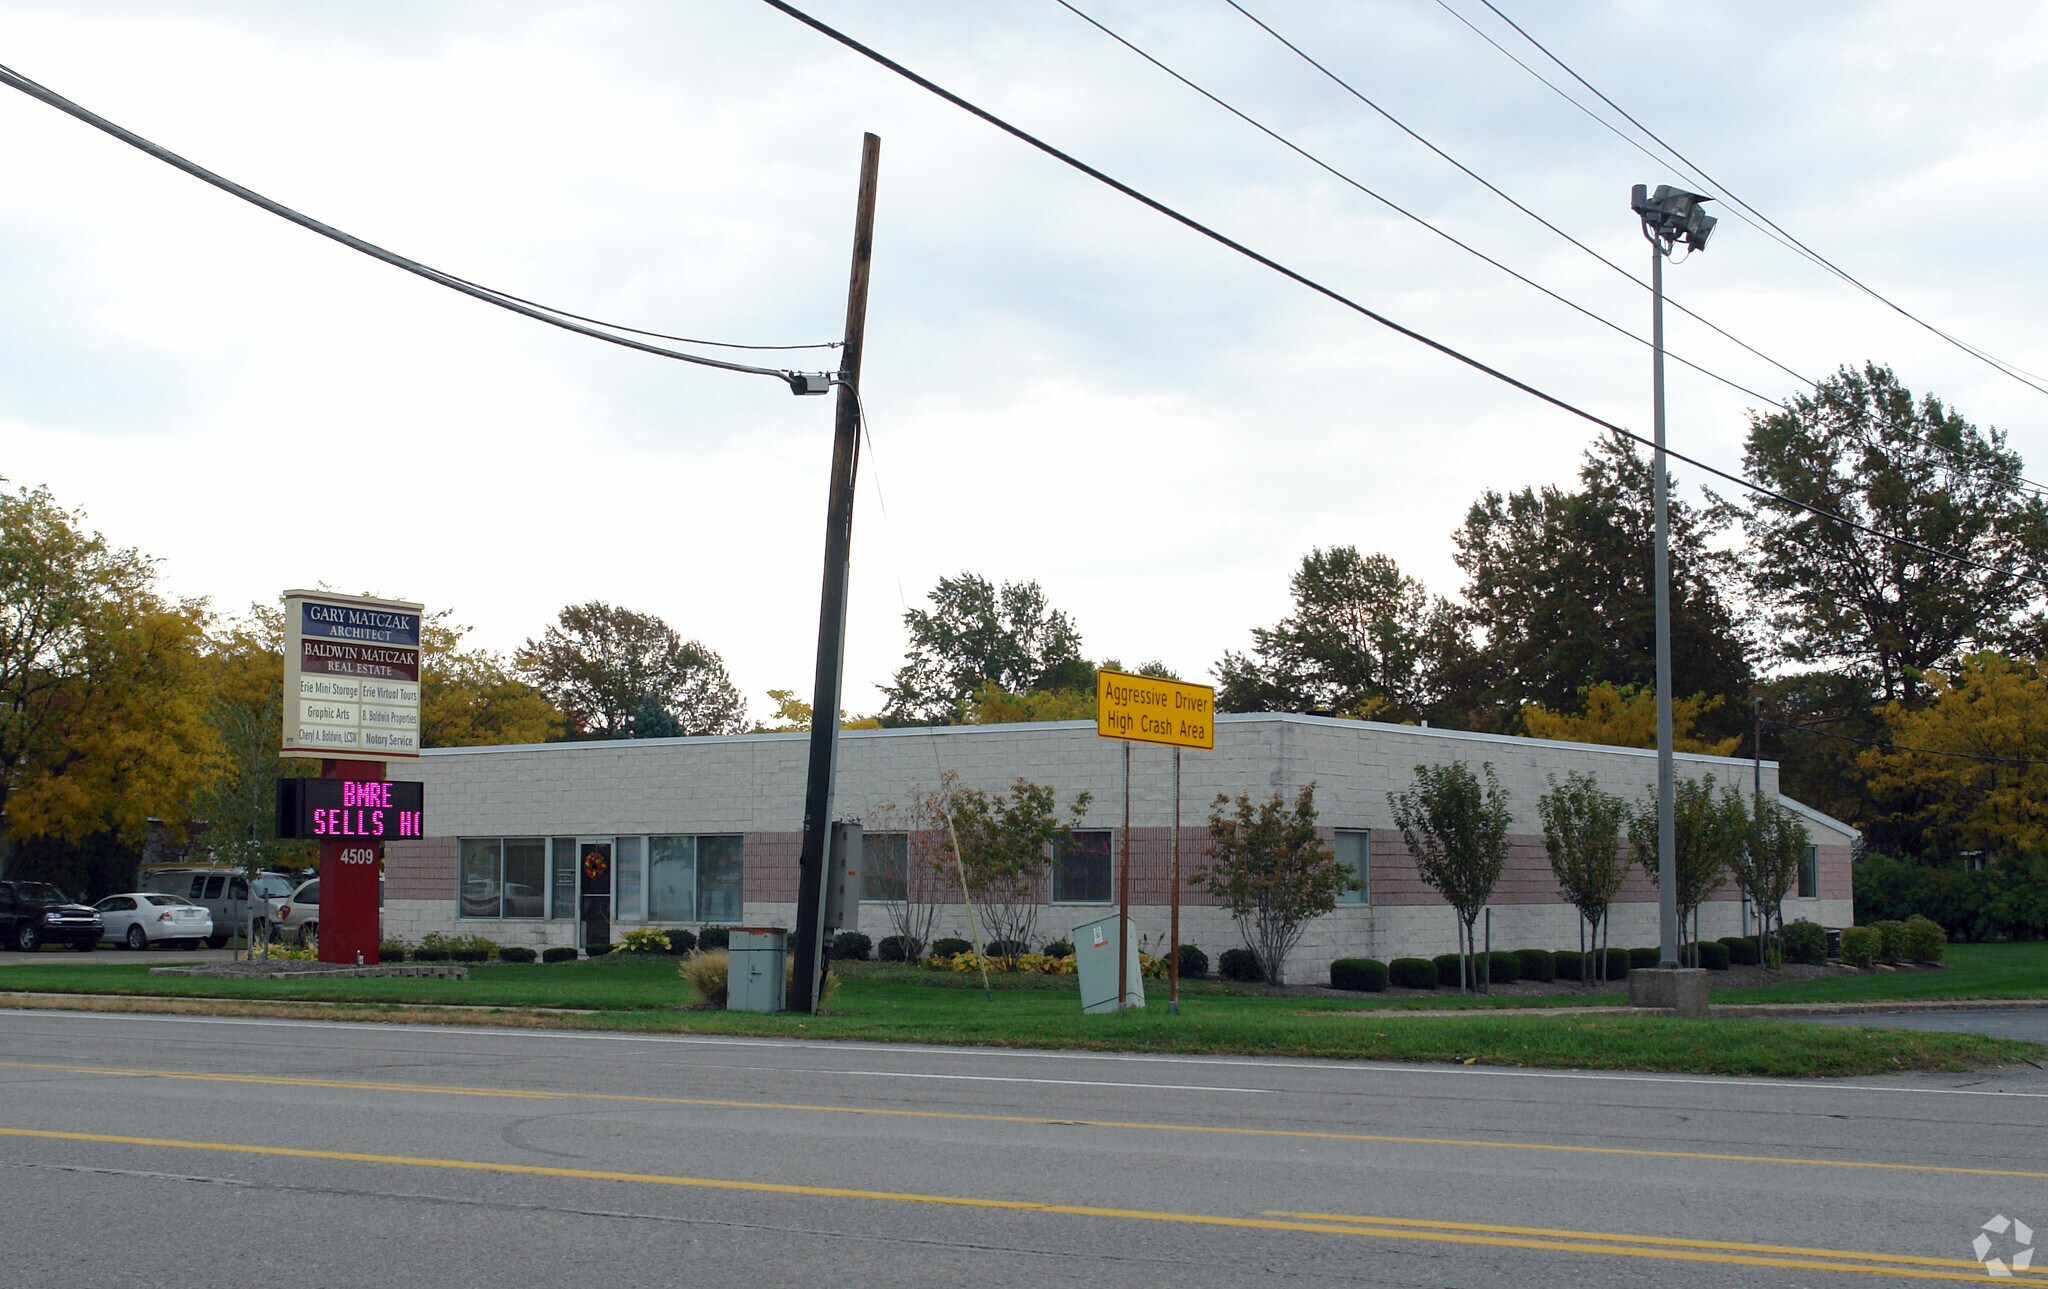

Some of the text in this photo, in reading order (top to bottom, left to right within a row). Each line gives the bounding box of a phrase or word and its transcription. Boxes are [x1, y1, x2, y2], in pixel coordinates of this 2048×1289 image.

[310, 606, 410, 630] GARY MATCZAK
[329, 625, 392, 641] ARCHITECT
[304, 642, 415, 665] BALDWIN MATCZAK
[328, 661, 393, 677] REAL ESTATE
[300, 680, 358, 699] Erie Mini Storage
[362, 686, 417, 701] Erie Virtual Tours
[1105, 681, 1208, 713] Aggressive Driver
[307, 706, 350, 720] Graphic Arts
[362, 710, 417, 726] B. Baldwin Properties
[1108, 710, 1205, 740] High Crash Area
[299, 728, 315, 743] Cheryl
[315, 730, 321, 742] A.
[322, 729, 343, 744] Baldwin,
[366, 733, 413, 747] Notary Service
[344, 781, 393, 808] BMRE
[313, 808, 384, 836] SELLS
[340, 848, 374, 865] 4509
